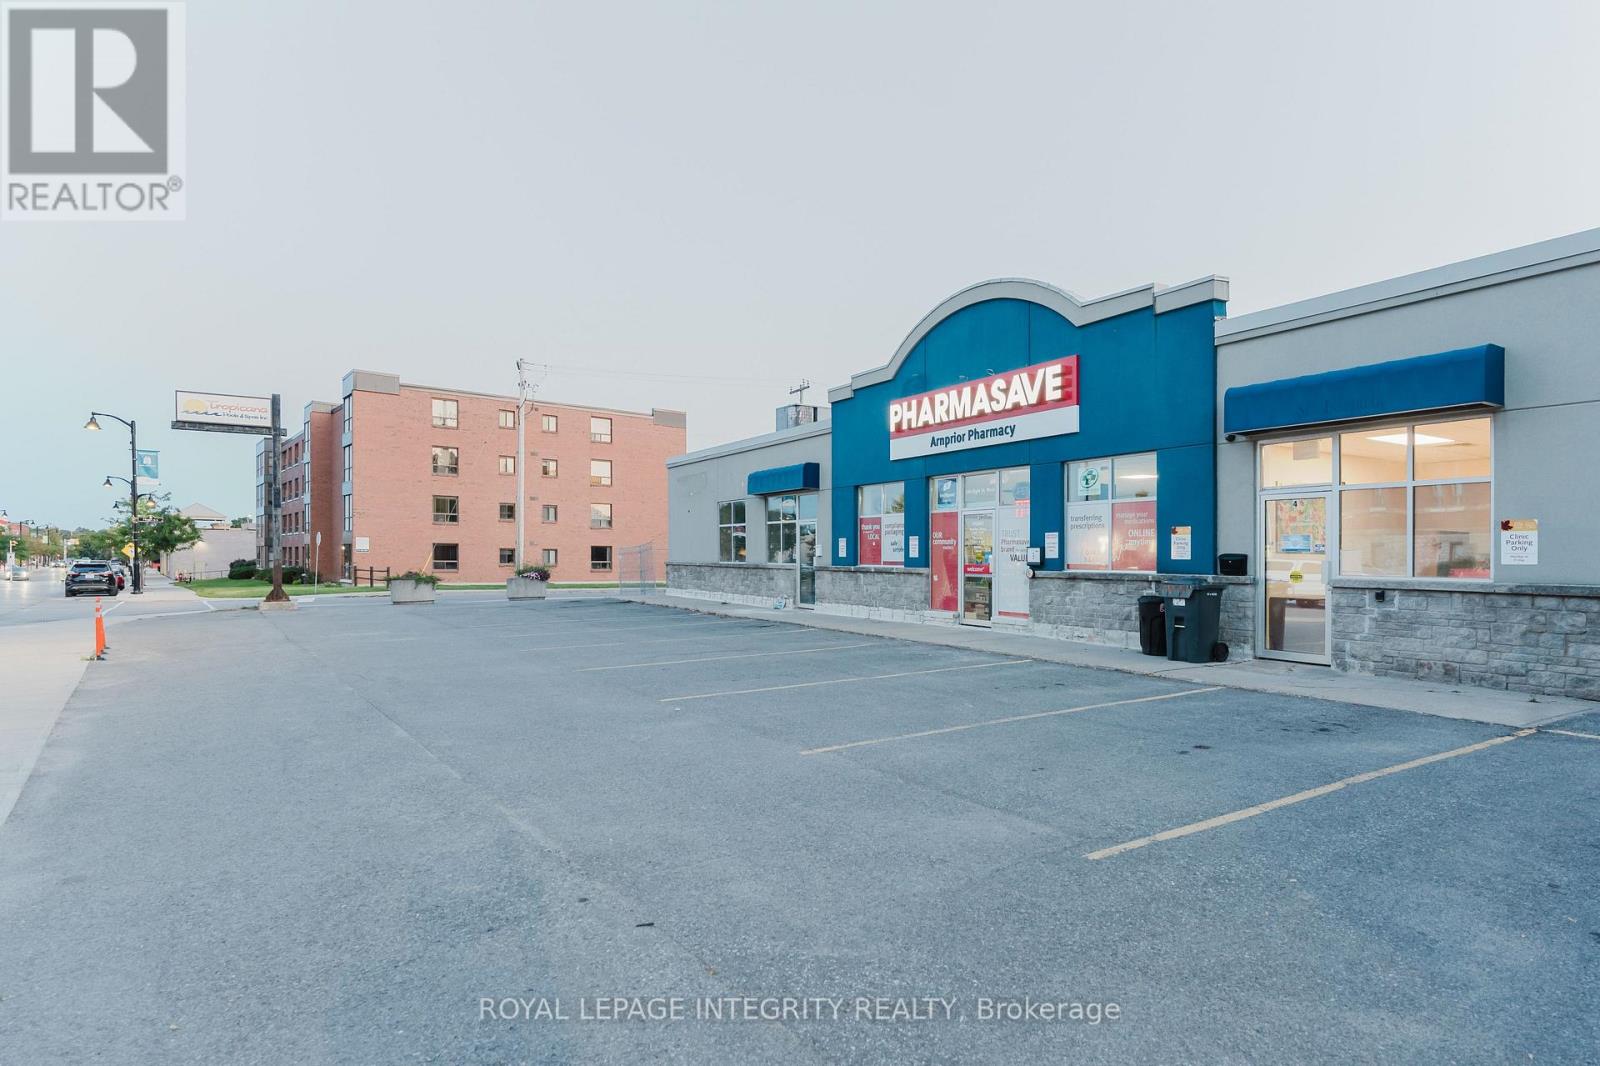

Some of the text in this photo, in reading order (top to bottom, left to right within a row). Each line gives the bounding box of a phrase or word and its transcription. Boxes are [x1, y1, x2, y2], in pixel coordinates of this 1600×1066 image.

[889, 364, 1062, 432] PHARMASAVE
[930, 424, 1016, 448] Arnprior Pharmacy
[1070, 514, 1103, 522] transferring
[1128, 529, 1155, 537] ONLINE
[932, 538, 956, 546] community
